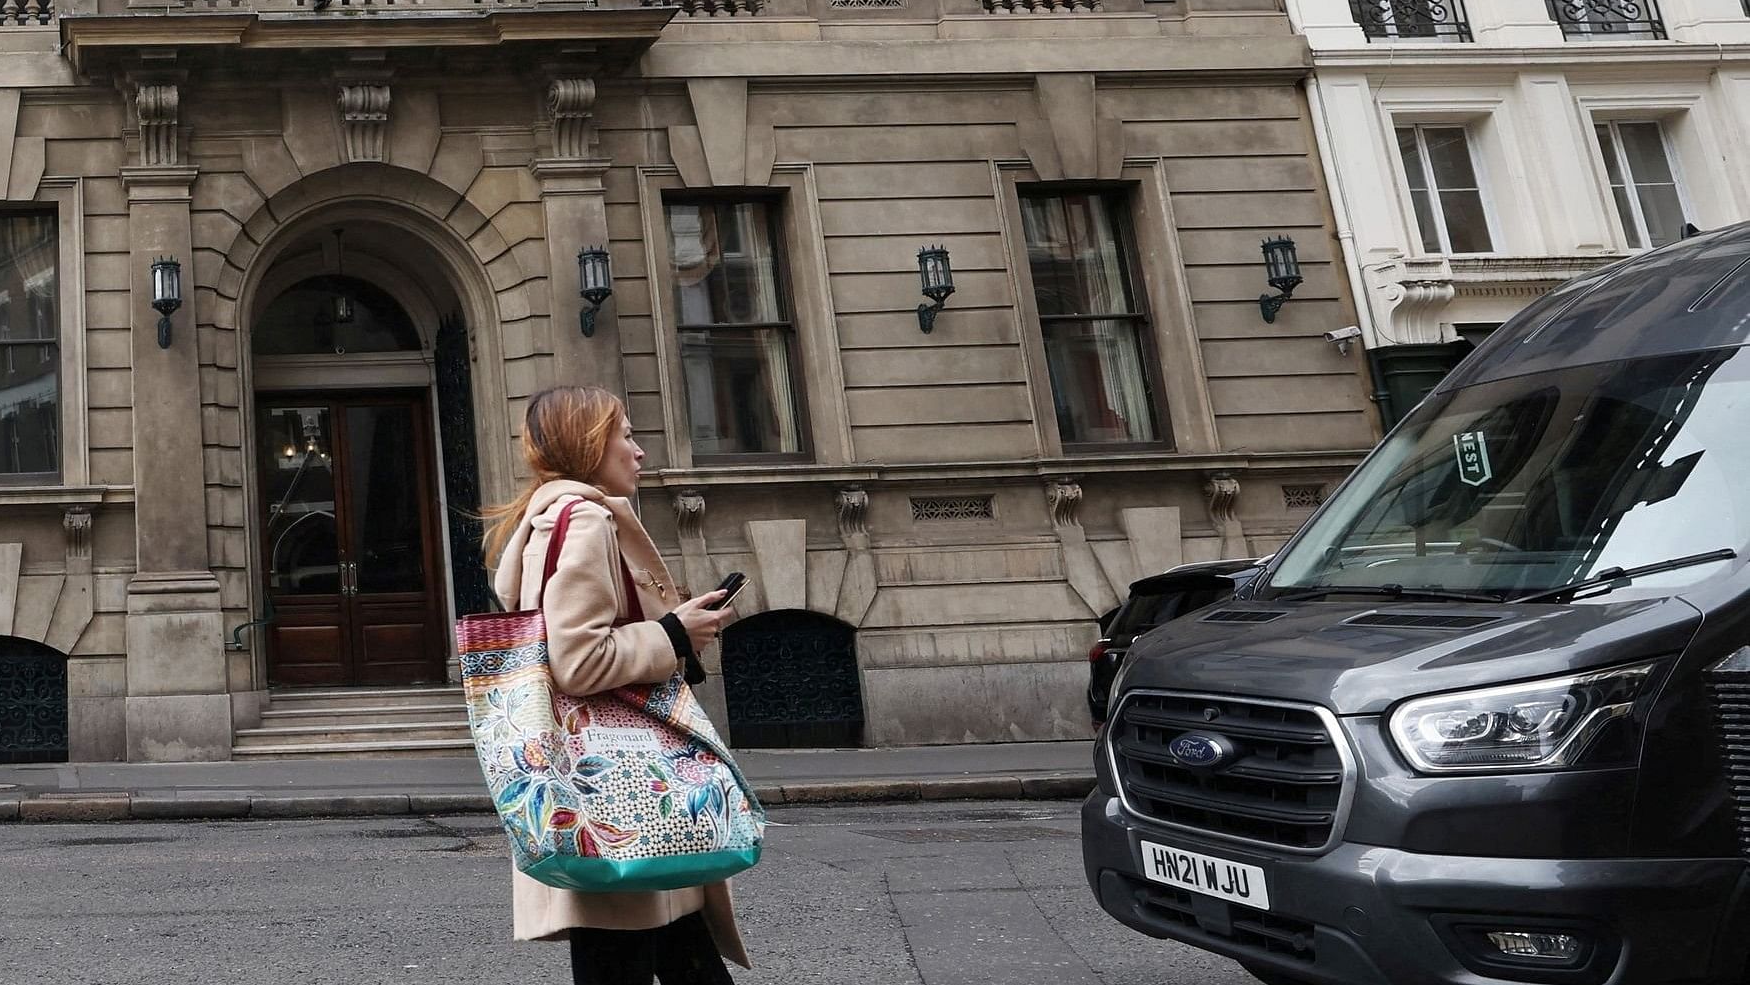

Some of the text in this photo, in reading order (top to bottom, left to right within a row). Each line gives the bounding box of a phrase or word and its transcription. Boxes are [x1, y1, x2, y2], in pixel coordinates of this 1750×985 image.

[585, 728, 653, 743] Fragonard
[1177, 739, 1206, 759] Ford
[1152, 847, 1250, 898] HN21 WJU
